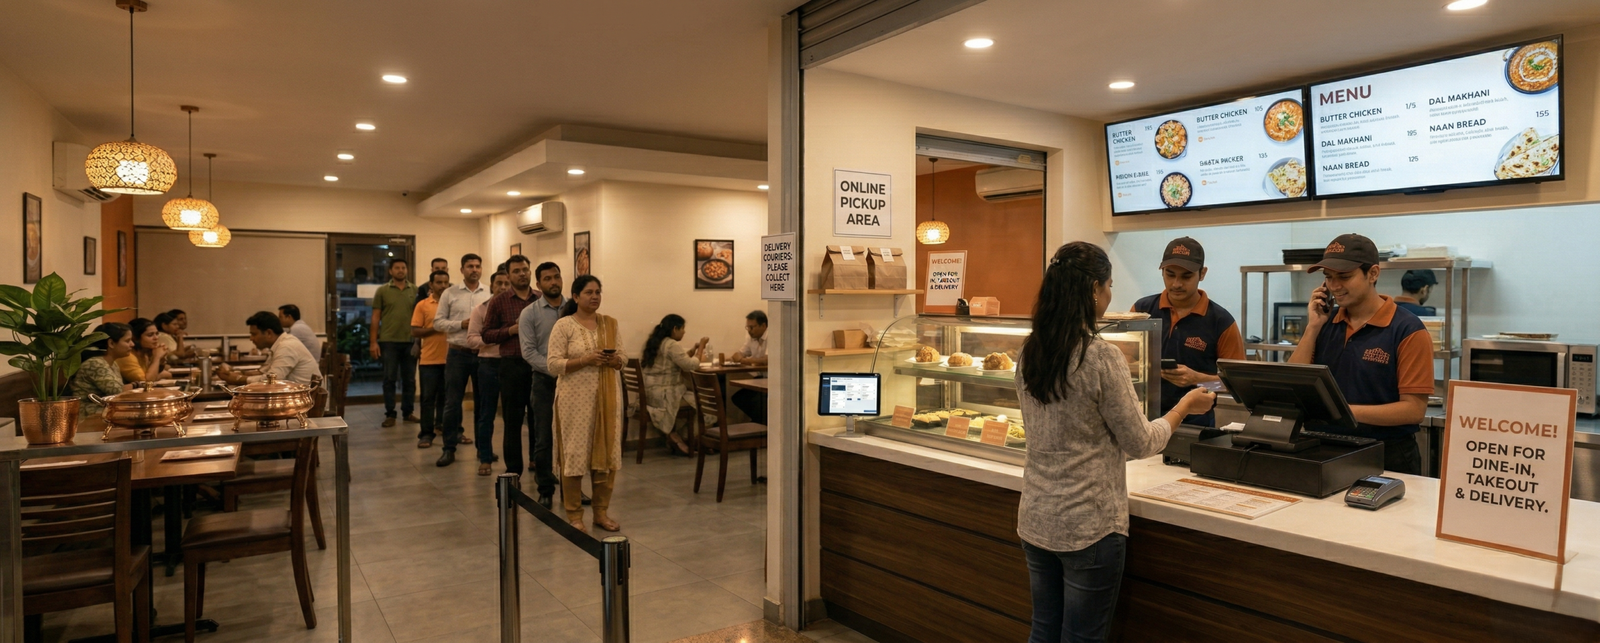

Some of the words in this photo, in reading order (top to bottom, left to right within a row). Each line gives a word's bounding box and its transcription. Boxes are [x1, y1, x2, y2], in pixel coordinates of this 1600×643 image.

[1320, 84, 1371, 106] MENU
[1428, 98, 1446, 106] DAL
[1448, 89, 1490, 102] MAKHANI
[1196, 114, 1219, 123] BUTTER
[1220, 109, 1247, 119] CHICKEN
[1320, 113, 1347, 123] BUTTER
[1349, 108, 1382, 118] CHICKEN
[1430, 123, 1454, 132] NAAN
[1456, 119, 1486, 129] BREAD
[1113, 136, 1136, 144] CHICKEN
[1338, 135, 1372, 146] MAKHANI
[1345, 161, 1370, 169] BREAD
[840, 180, 886, 195] ONLINE
[841, 197, 886, 210] PICKUP
[846, 213, 880, 226] AREA
[764, 242, 791, 251] DELIVERY
[763, 252, 792, 261] COURIERS:
[767, 263, 788, 271] PLEASE
[766, 273, 790, 281] COLLECT
[1459, 415, 1558, 438] WELCOME!
[1466, 440, 1508, 456] OPEN
[1513, 446, 1545, 460] FOR
[1472, 457, 1535, 478] DINE-IN,
[1466, 472, 1538, 493] TAKEOUT
[1455, 488, 1465, 499] &
[1470, 490, 1548, 513] DELIVERY.
